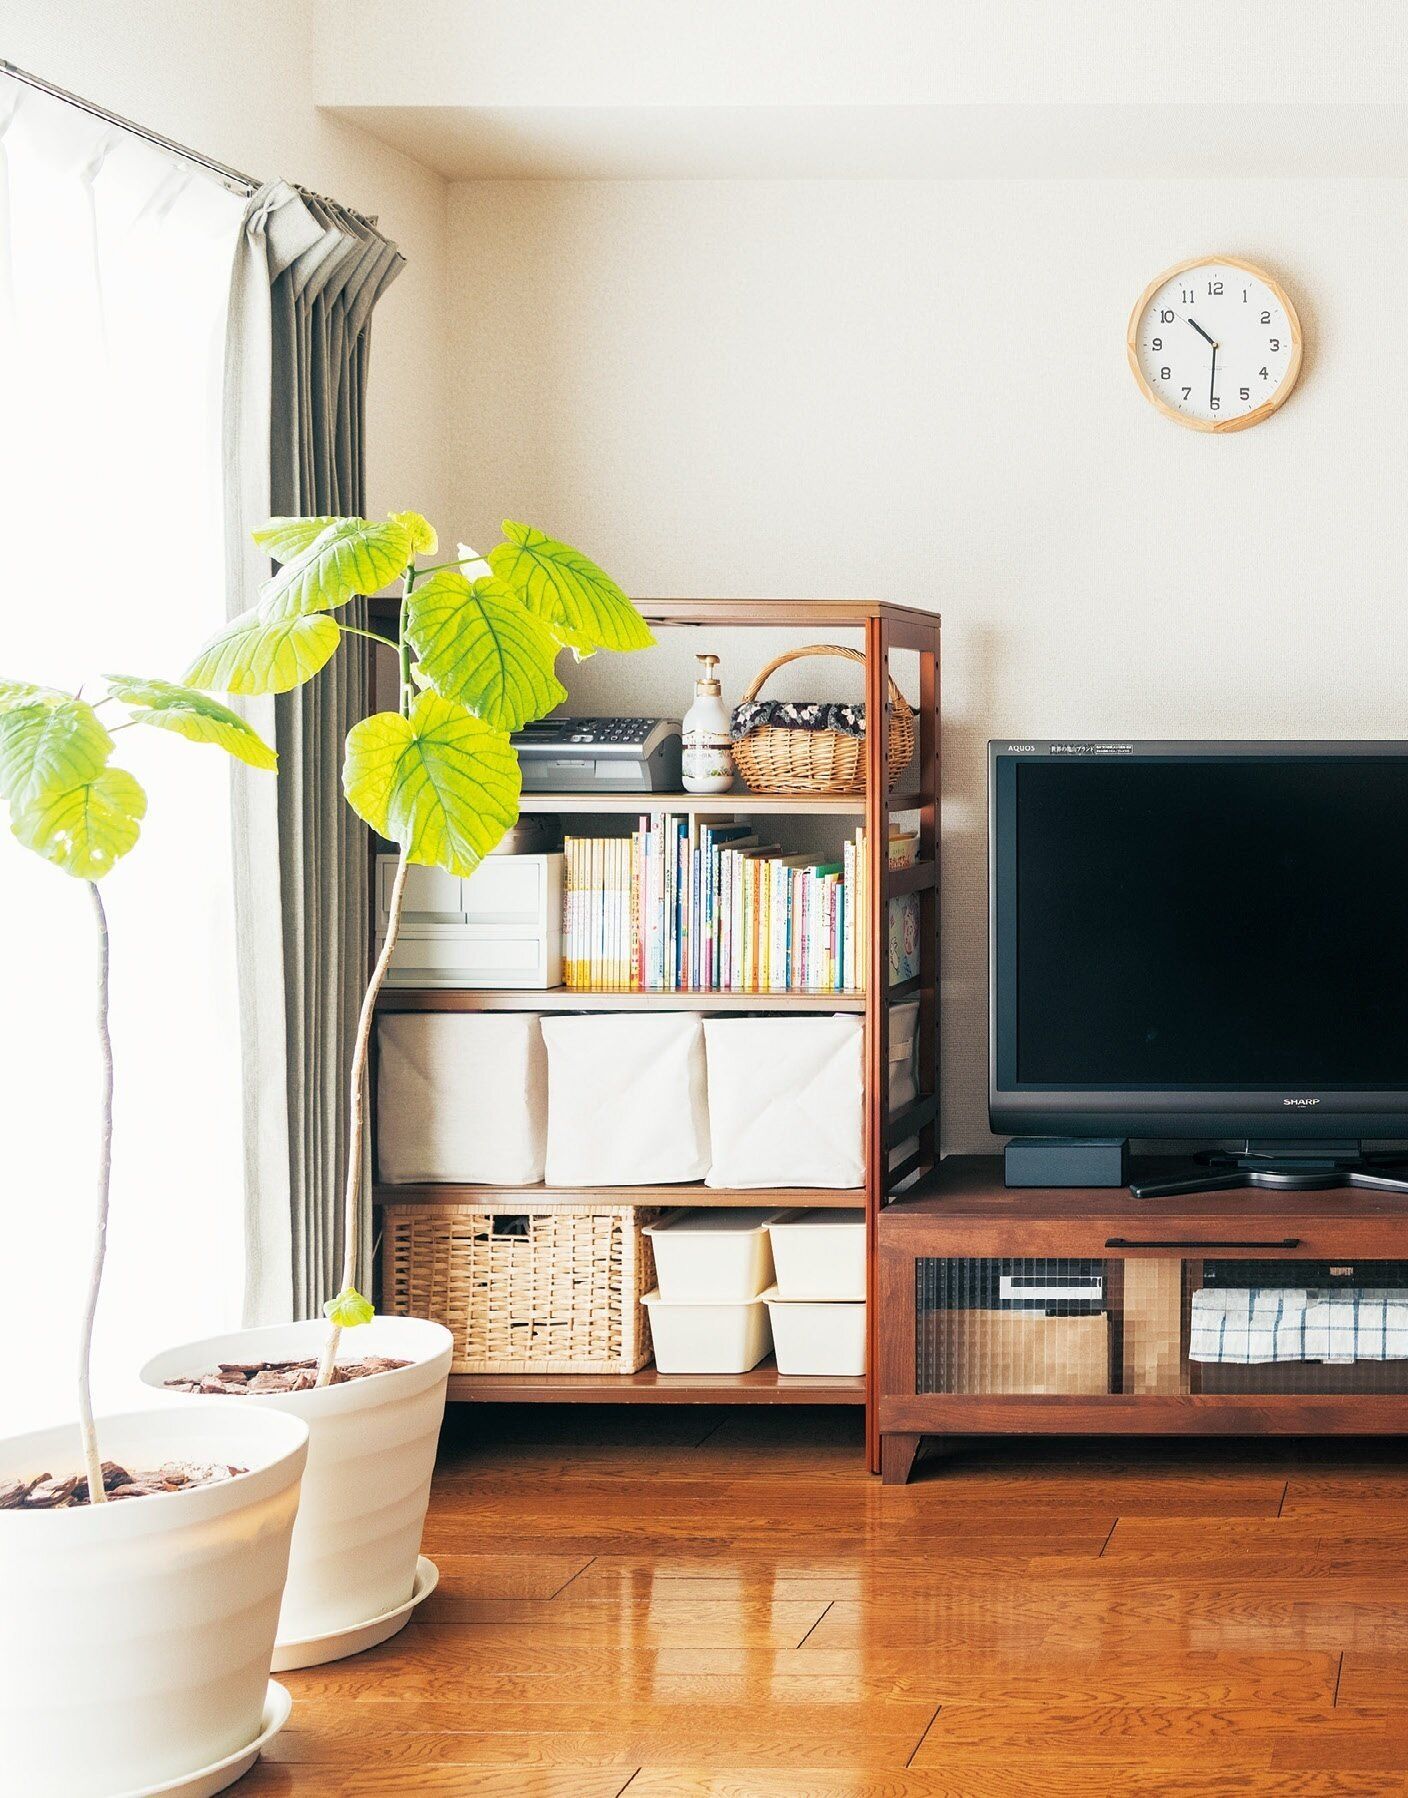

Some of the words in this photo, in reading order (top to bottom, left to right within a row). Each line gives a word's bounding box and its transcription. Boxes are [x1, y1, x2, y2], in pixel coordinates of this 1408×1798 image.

[1208, 282, 1224, 296] 12
[1182, 290, 1195, 304] 11
[1242, 290, 1248, 303] 1
[1160, 310, 1175, 323] 10
[1260, 311, 1271, 324] 2
[1152, 338, 1163, 351] 9
[1269, 339, 1280, 352] 3
[1160, 366, 1171, 380] 8
[1258, 367, 1269, 380] 4
[1181, 387, 1192, 401] 7
[1239, 387, 1250, 401] 5
[1210, 397, 1220, 410] 6
[1008, 745, 1035, 753] AQUOS
[1283, 1098, 1321, 1106] SHARP
